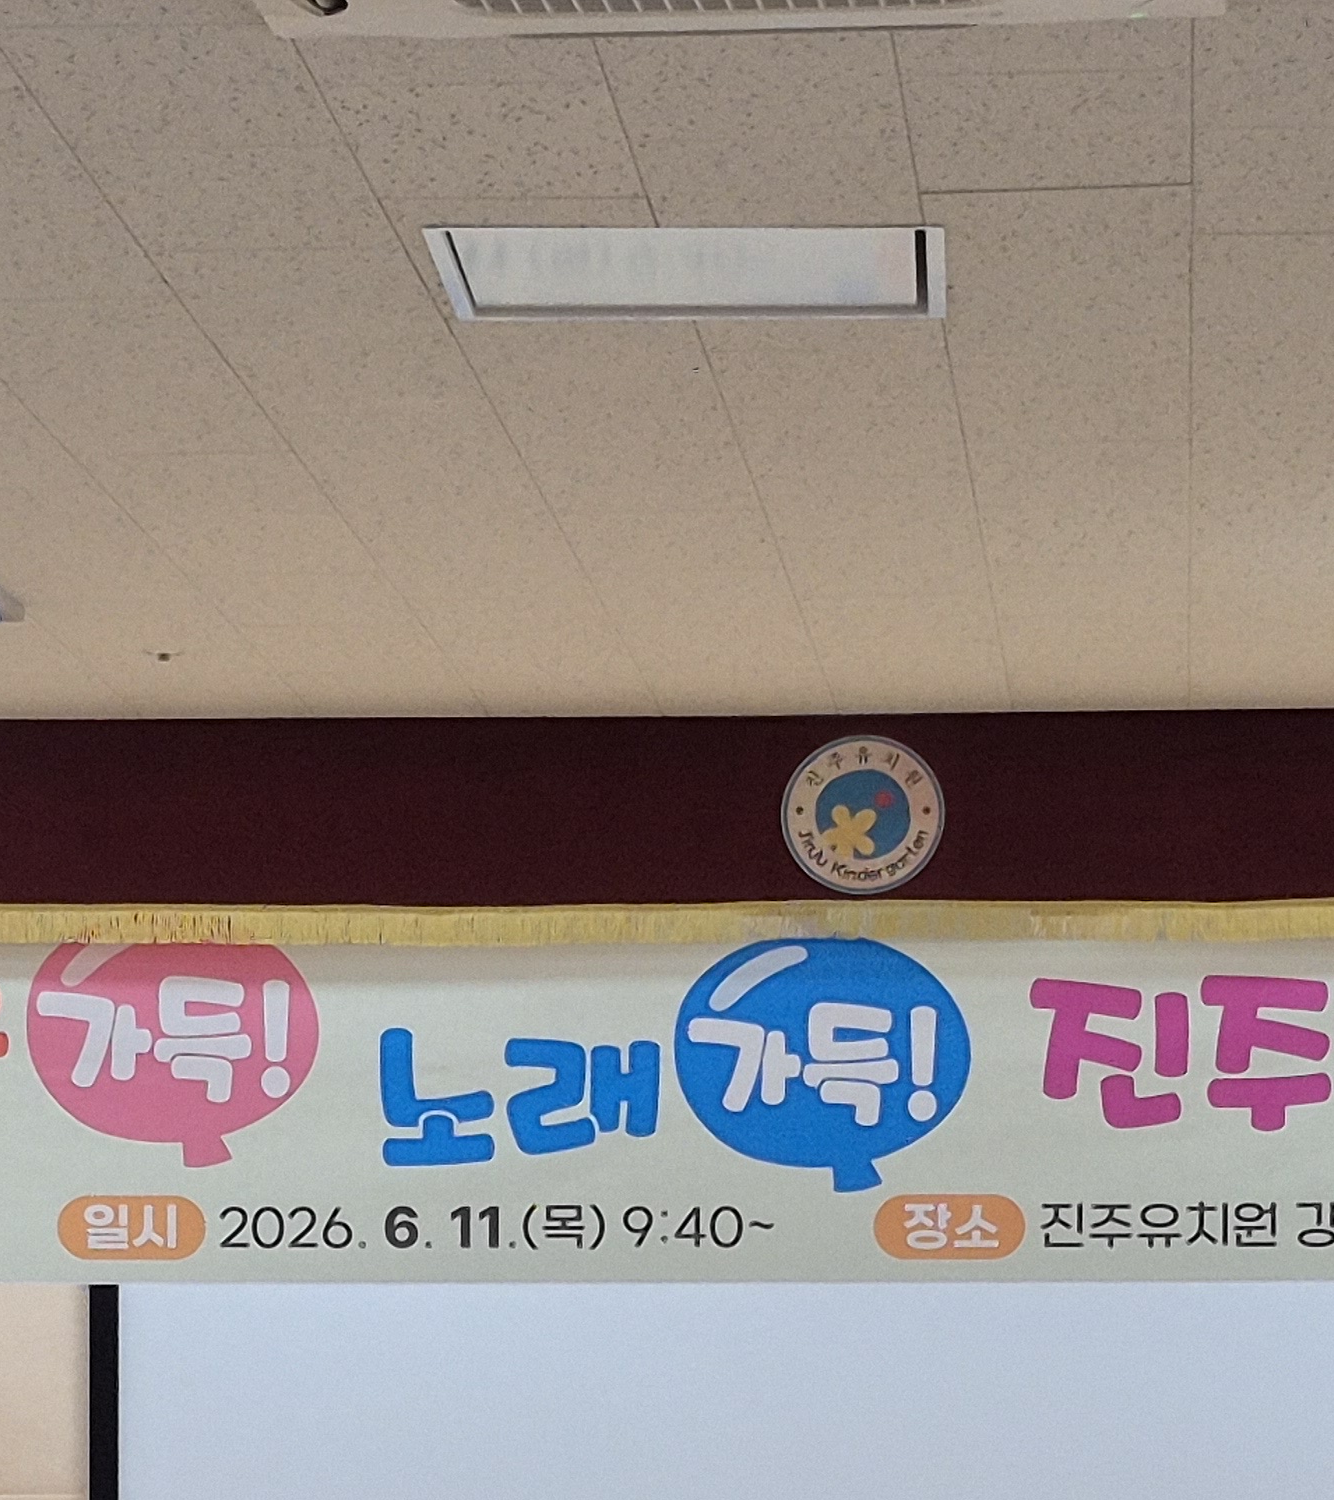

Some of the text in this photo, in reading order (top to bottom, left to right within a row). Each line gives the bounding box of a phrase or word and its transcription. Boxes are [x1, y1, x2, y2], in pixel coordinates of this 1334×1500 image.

[37, 975, 291, 1104] 가득!
[380, 1028, 660, 1166] 노래
[687, 1002, 937, 1126] 가득!
[1030, 975, 1332, 1132] 진주
[83, 1203, 178, 1250] 일시
[219, 1206, 367, 1249] 2026.
[384, 1205, 433, 1249] 6.
[903, 1203, 1001, 1251] 장소
[1040, 1200, 1278, 1249] 진주유치원
